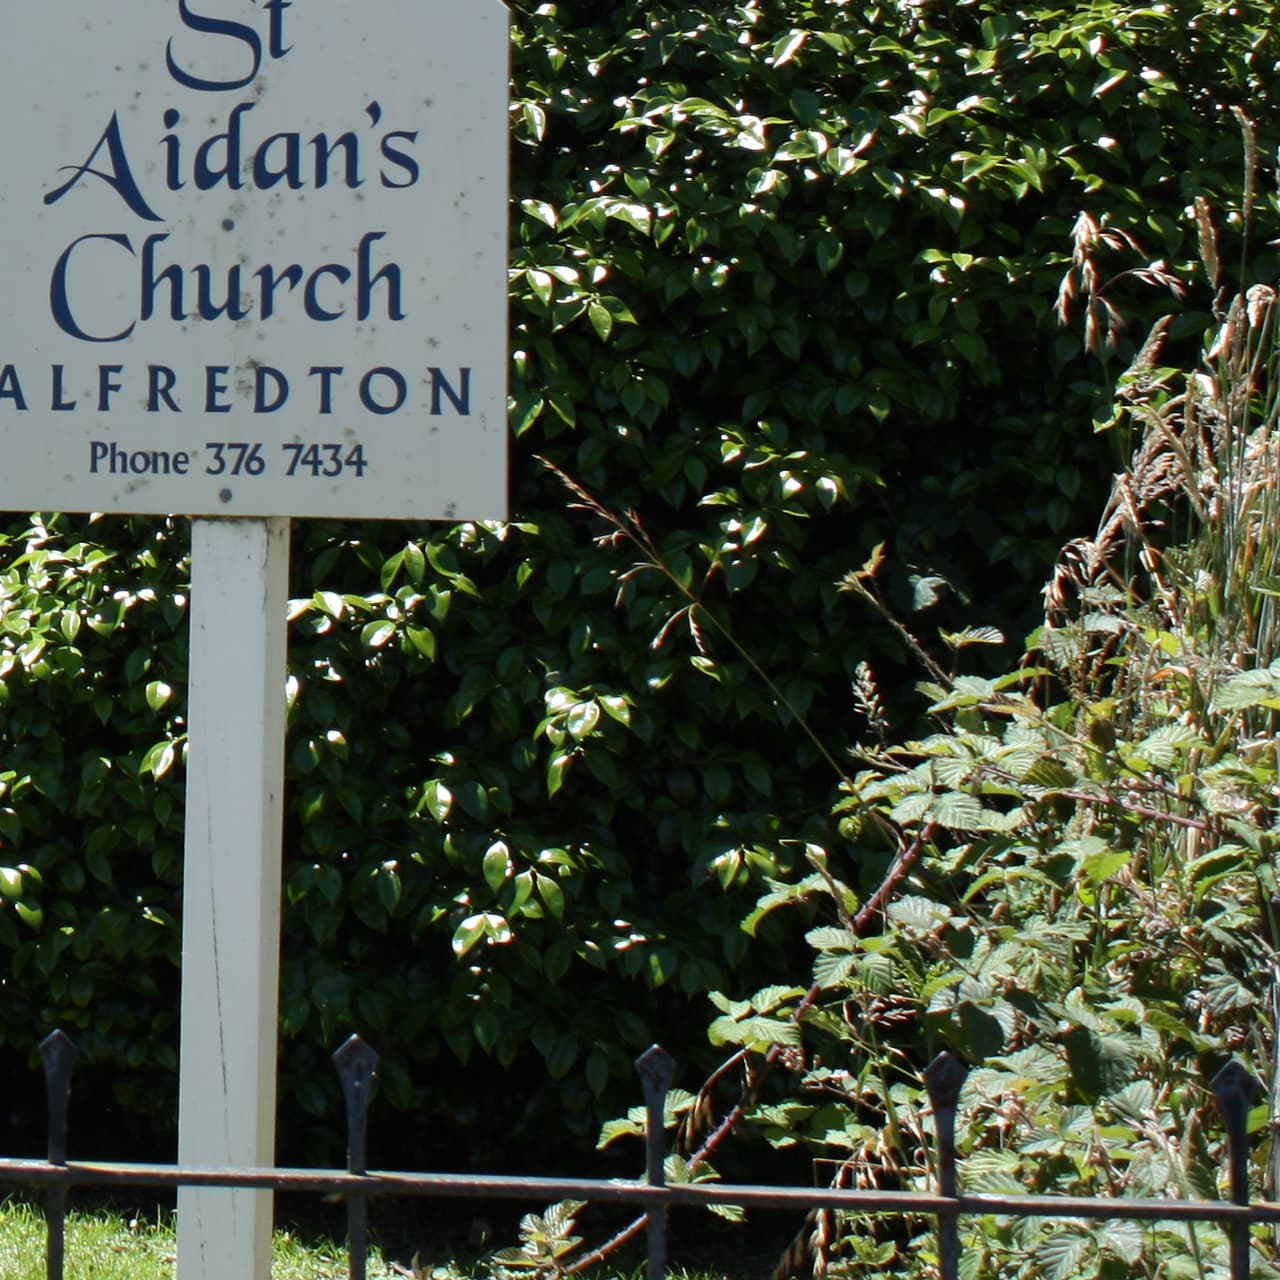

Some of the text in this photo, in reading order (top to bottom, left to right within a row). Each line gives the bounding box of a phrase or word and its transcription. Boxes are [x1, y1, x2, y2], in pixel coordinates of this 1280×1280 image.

[44, 100, 420, 223] Aidan's
[49, 231, 407, 343] Church
[89, 440, 368, 478] Phone 376 7434
